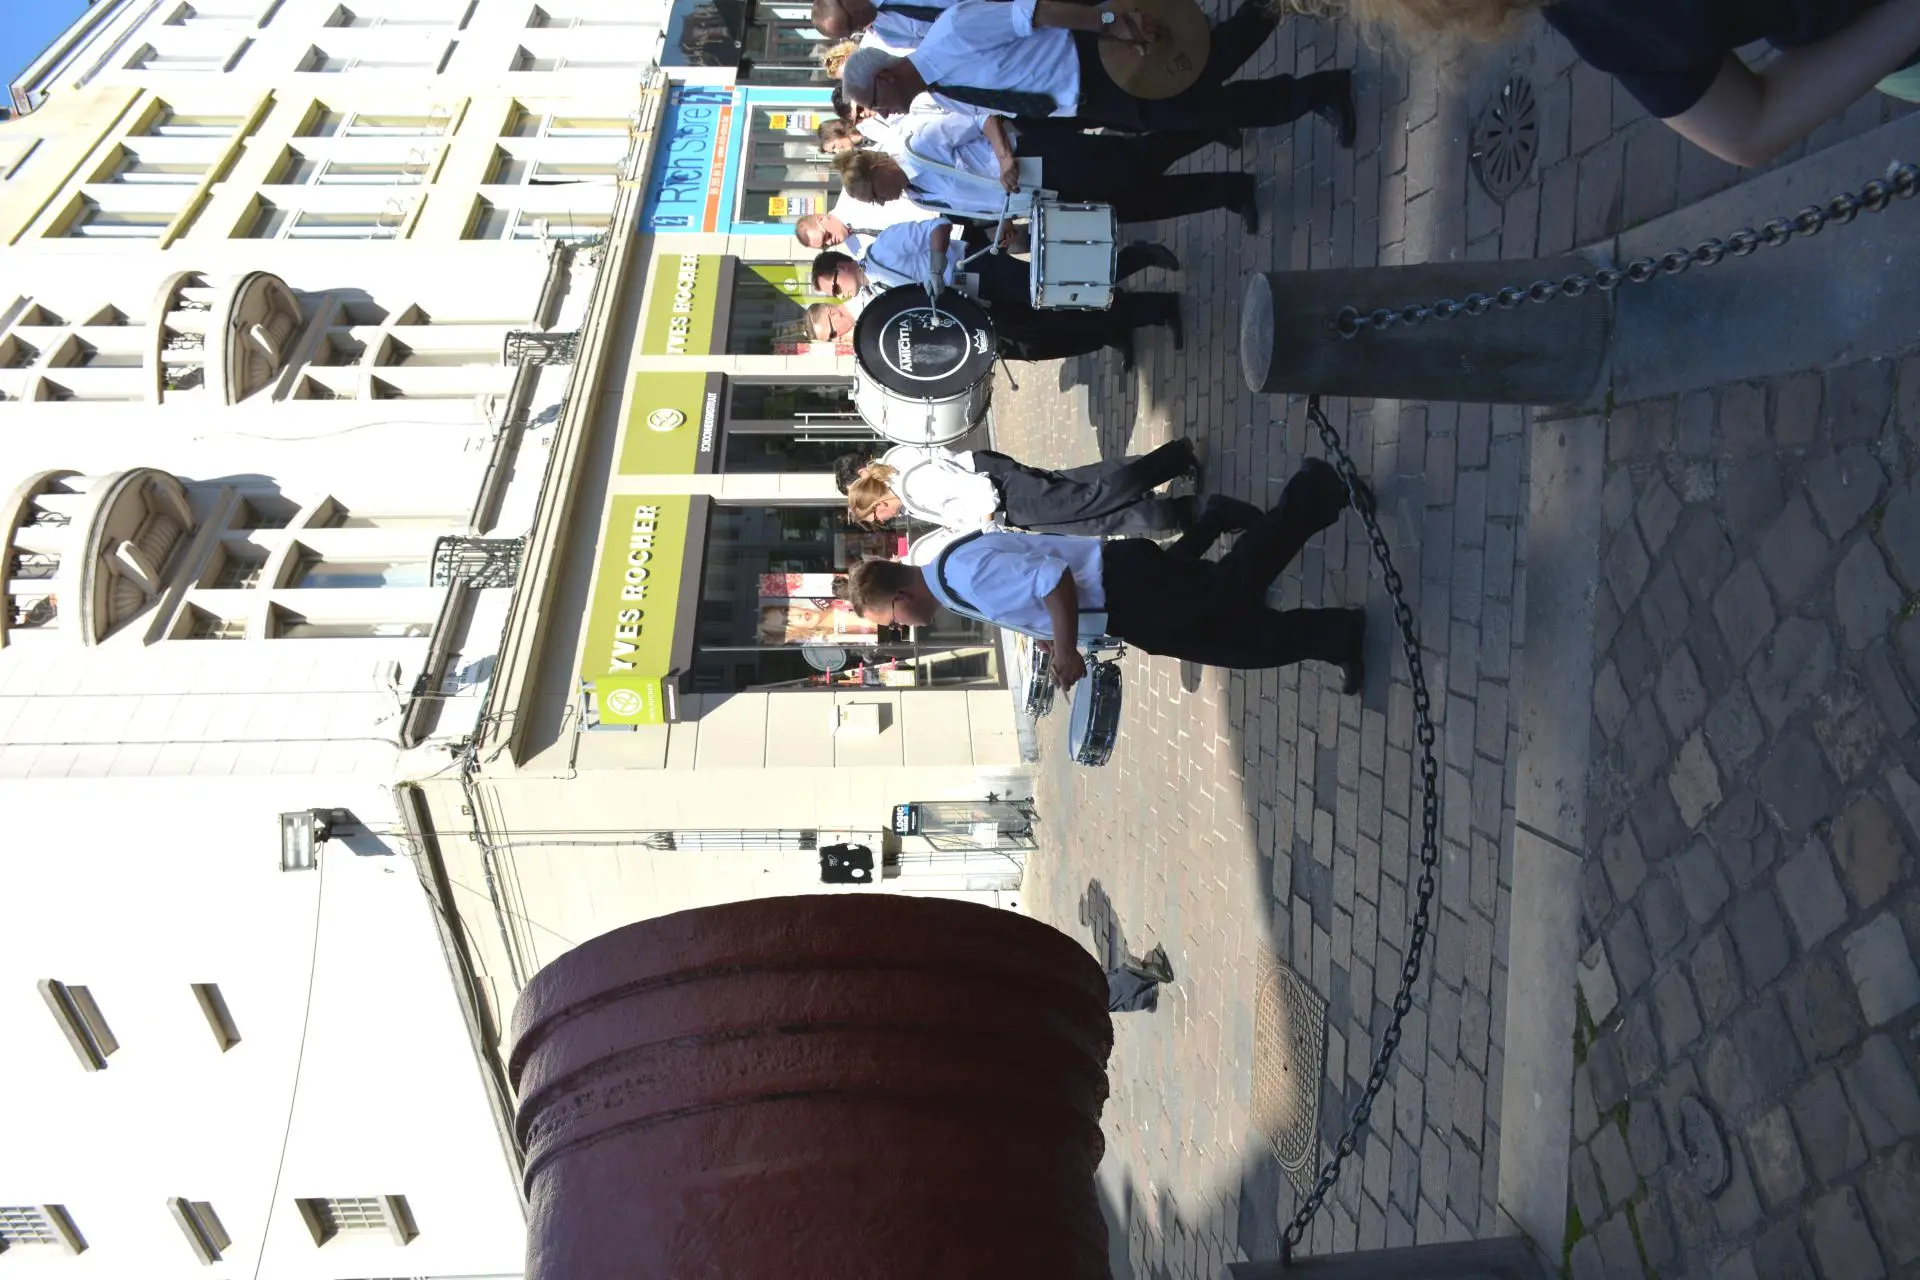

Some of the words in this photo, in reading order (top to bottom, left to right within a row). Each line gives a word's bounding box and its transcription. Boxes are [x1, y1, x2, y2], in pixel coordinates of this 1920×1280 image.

[665, 108, 712, 153] Store
[654, 158, 704, 203] Rich
[672, 254, 698, 313] ROCHER
[666, 317, 690, 355] YVES
[899, 319, 912, 372] AMICITIA
[621, 505, 657, 601] ROCHER
[608, 609, 641, 674] YVES
[896, 807, 904, 832] LOGIC
